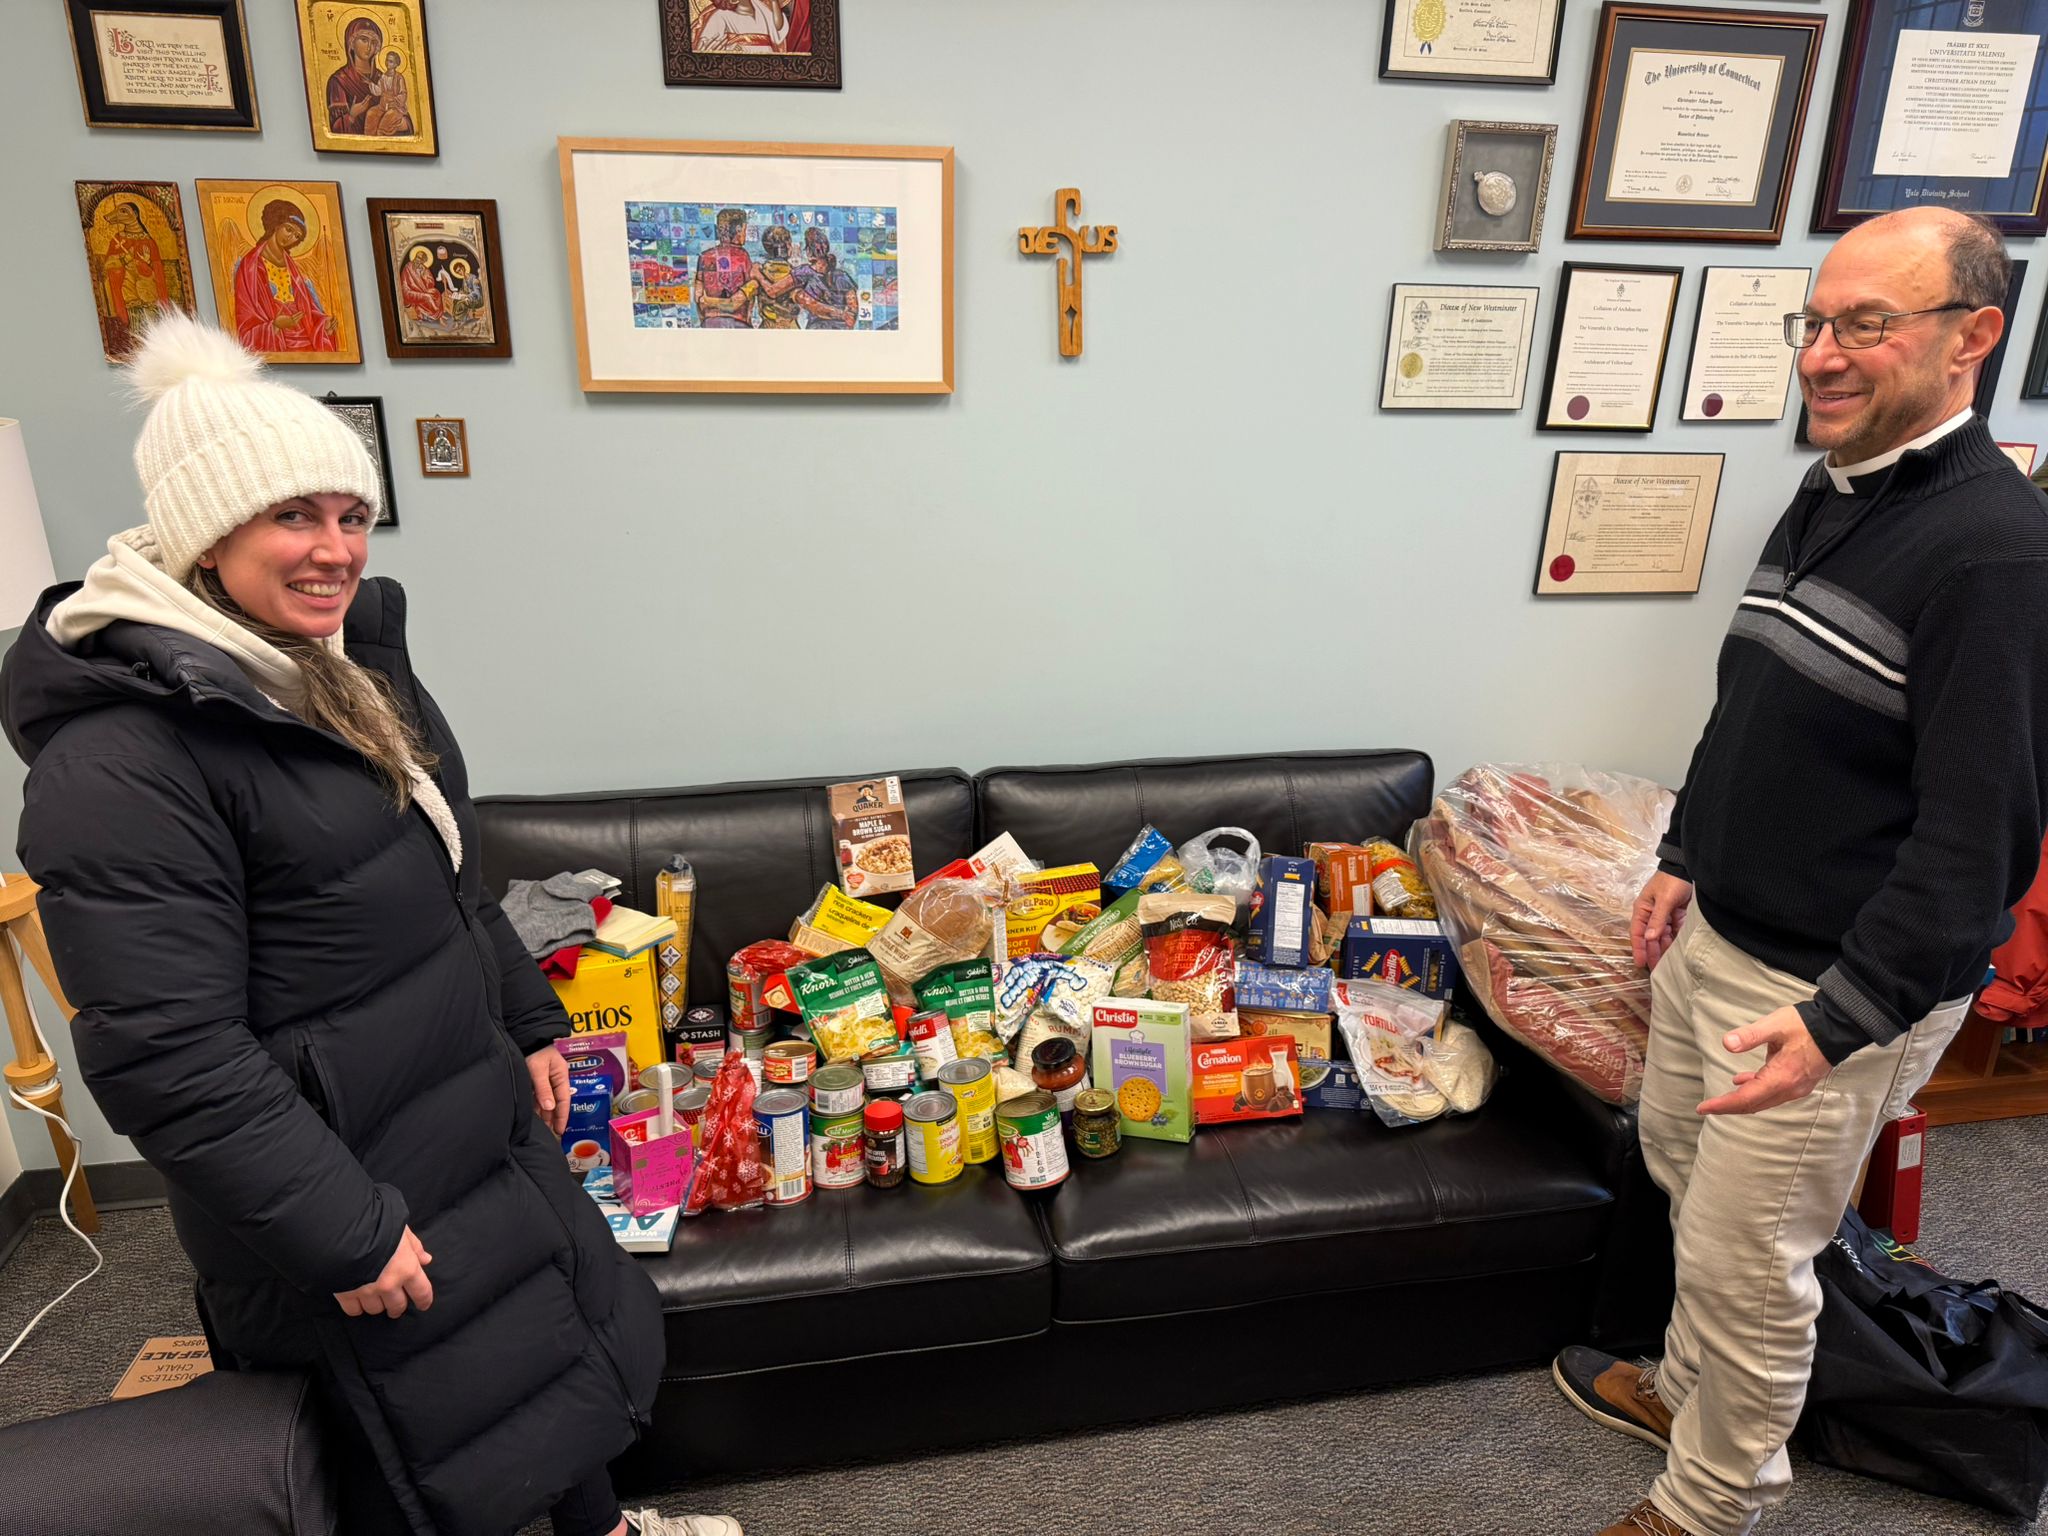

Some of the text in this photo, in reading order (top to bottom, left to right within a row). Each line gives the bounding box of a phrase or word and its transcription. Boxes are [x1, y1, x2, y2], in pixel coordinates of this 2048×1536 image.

[1644, 62, 1761, 92] The University of Connecticut
[1905, 188, 1970, 199] Yale Divinity School
[1440, 303, 1460, 311] Diocese
[1461, 303, 1467, 313] of
[1483, 304, 1518, 312] Westminster
[852, 801, 884, 812] QUAKER
[859, 819, 878, 828] MAPLE
[852, 827, 873, 836] BROWN
[873, 824, 892, 833] SUGAR
[1034, 898, 1053, 907] Paso
[833, 900, 872, 921] rice crackers
[828, 908, 860, 926] craquelins
[1008, 939, 1031, 956] SOFT TACO
[1386, 951, 1398, 985] Barilla
[800, 978, 837, 995] Knorr
[922, 984, 954, 997] Knorr
[1095, 1008, 1136, 1023] Christie
[691, 1030, 721, 1039] STASH
[1119, 1053, 1157, 1062] BLUEBERRY
[1198, 1052, 1242, 1069] Carnation
[569, 1059, 597, 1069] TELLI
[1140, 1060, 1162, 1069] SUGAR
[571, 1102, 596, 1112] Tetley
[155, 1363, 194, 1372] CHALK
[140, 1373, 198, 1383] DUSTLESS
